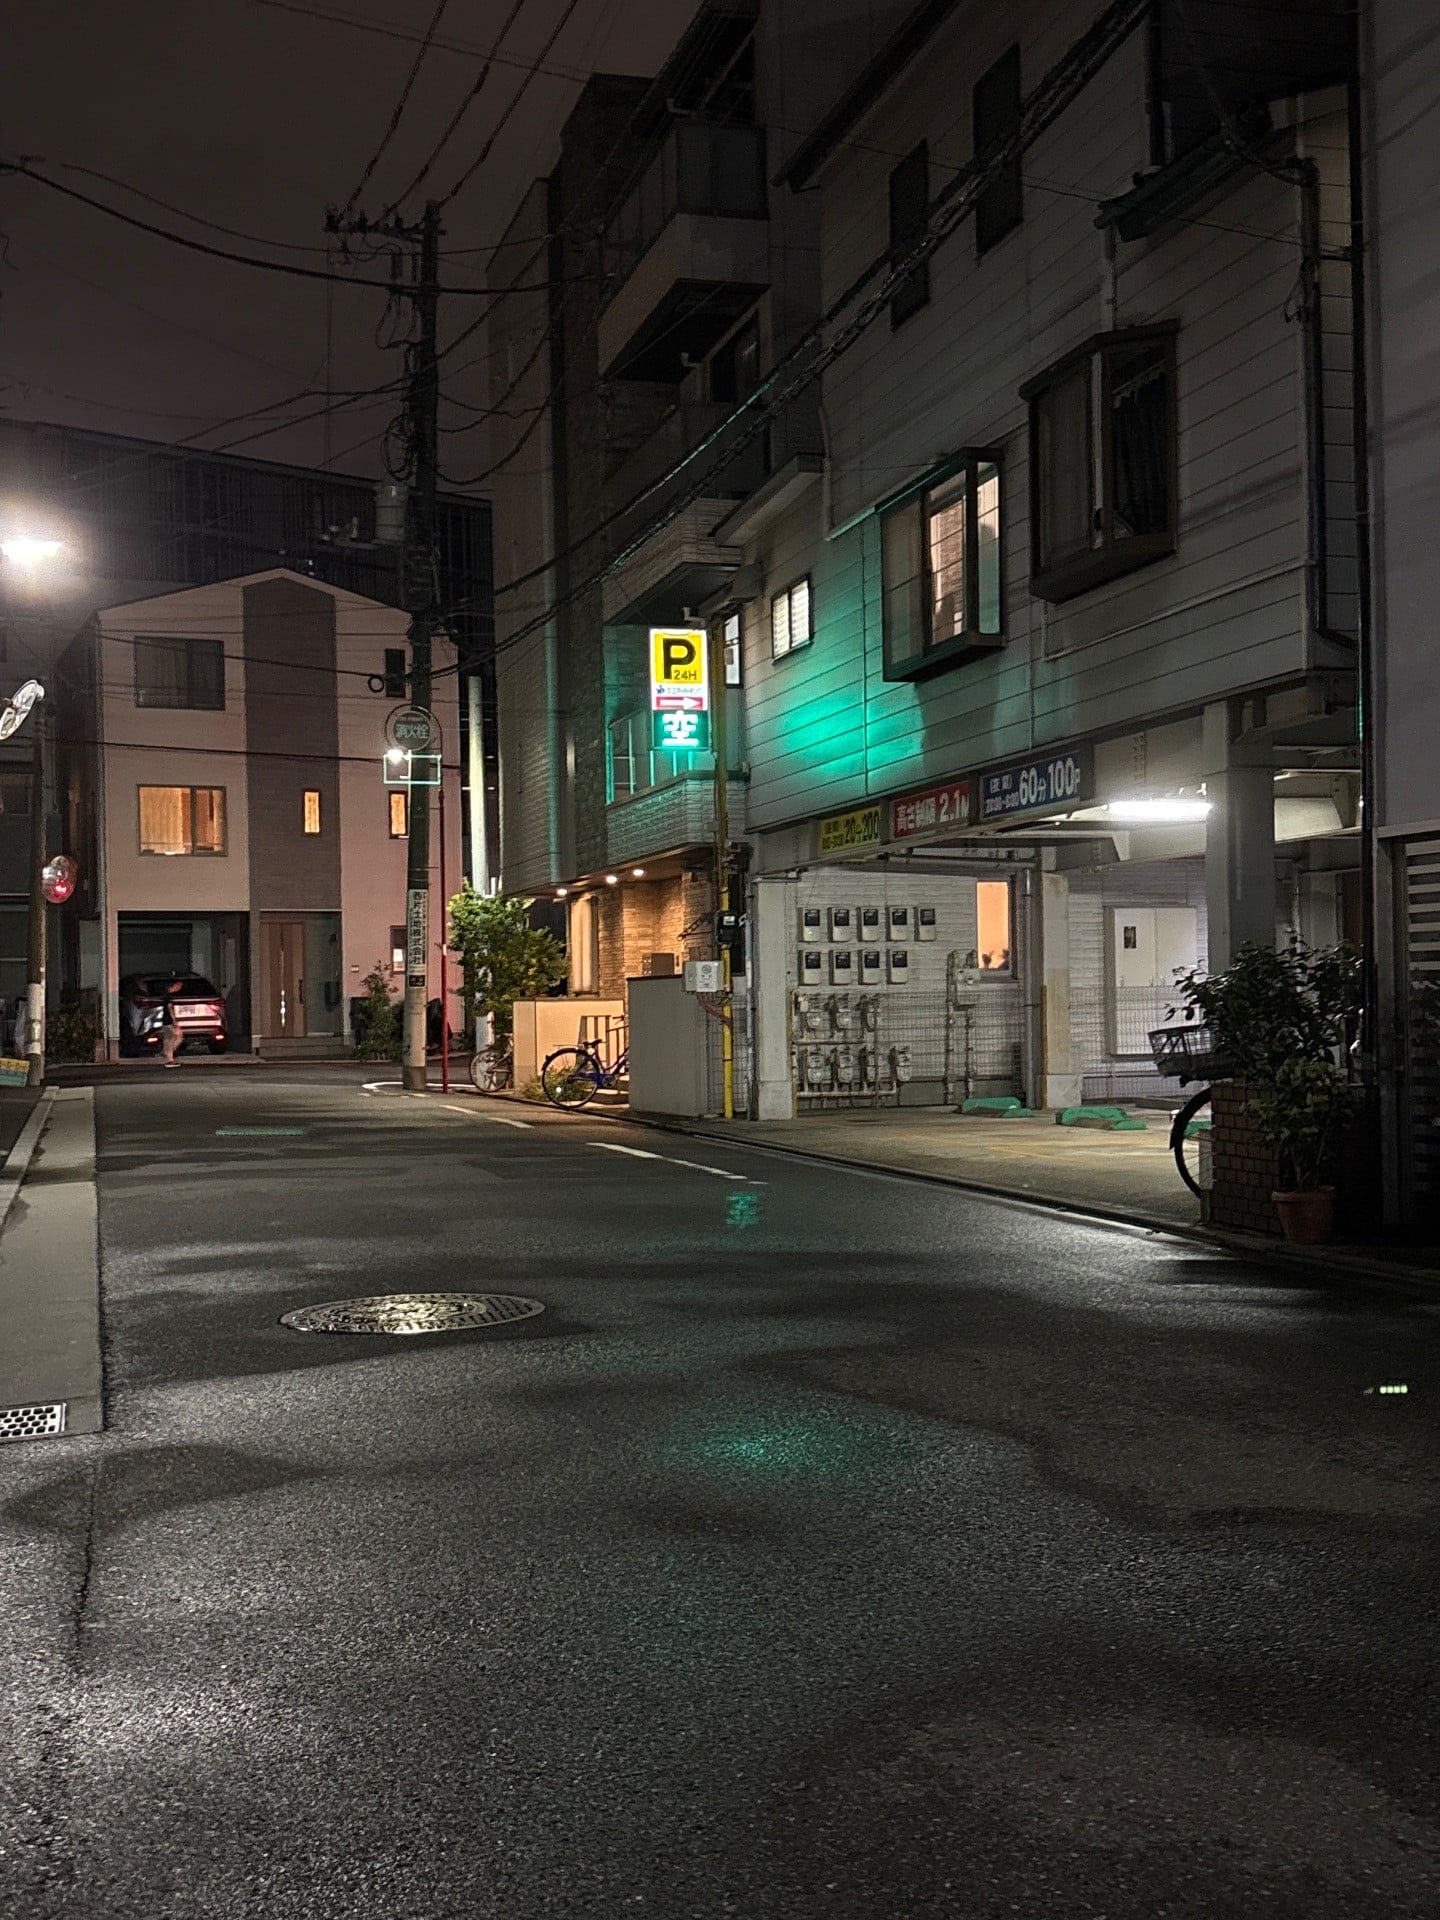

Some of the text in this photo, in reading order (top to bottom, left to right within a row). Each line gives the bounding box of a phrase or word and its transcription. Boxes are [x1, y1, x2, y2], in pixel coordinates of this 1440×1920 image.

[662, 638, 696, 680] P
[673, 669, 698, 681] 24H
[395, 723, 430, 739] 消火栓
[661, 709, 700, 747] 空
